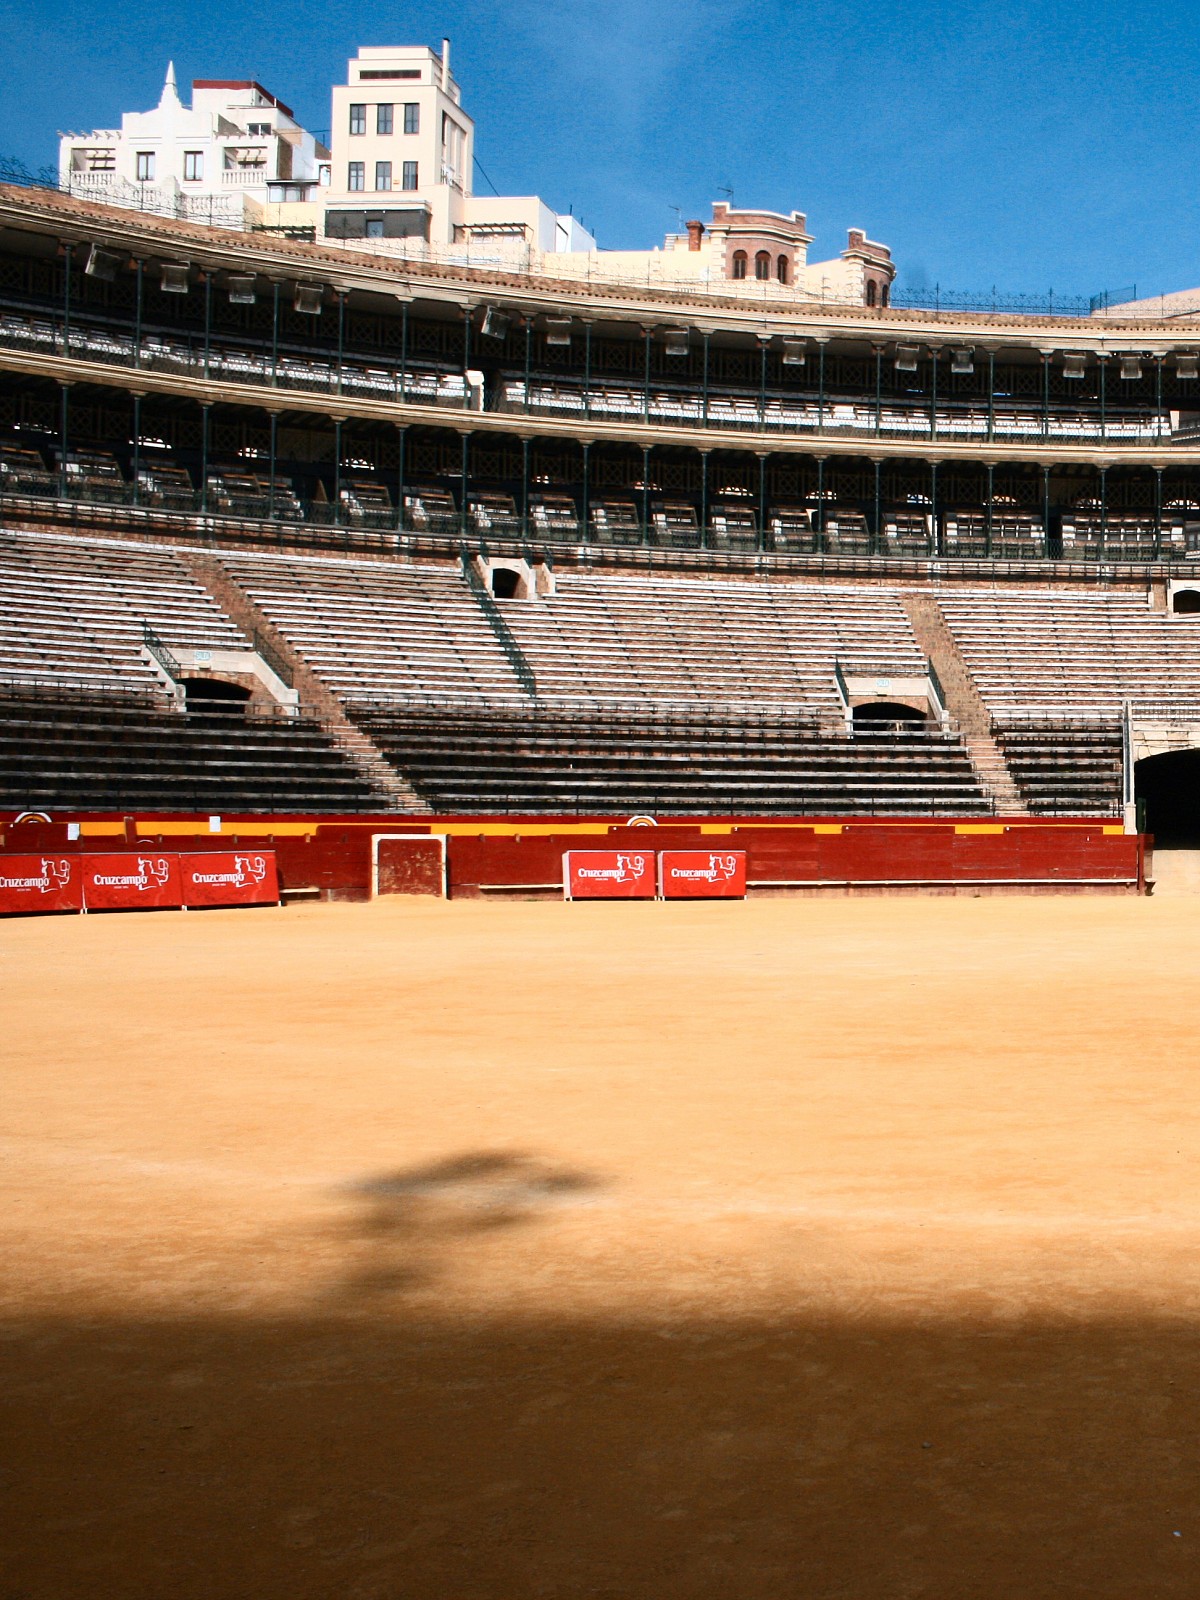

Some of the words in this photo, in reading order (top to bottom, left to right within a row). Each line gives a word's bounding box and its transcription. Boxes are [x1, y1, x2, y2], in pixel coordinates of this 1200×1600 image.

[192, 872, 244, 885] Cruzcampo
[578, 868, 625, 879] Cruzcampo
[671, 868, 717, 879] Cruzcampo
[0, 876, 50, 888] Cruzcampo
[94, 874, 147, 887] Cruzcampo
